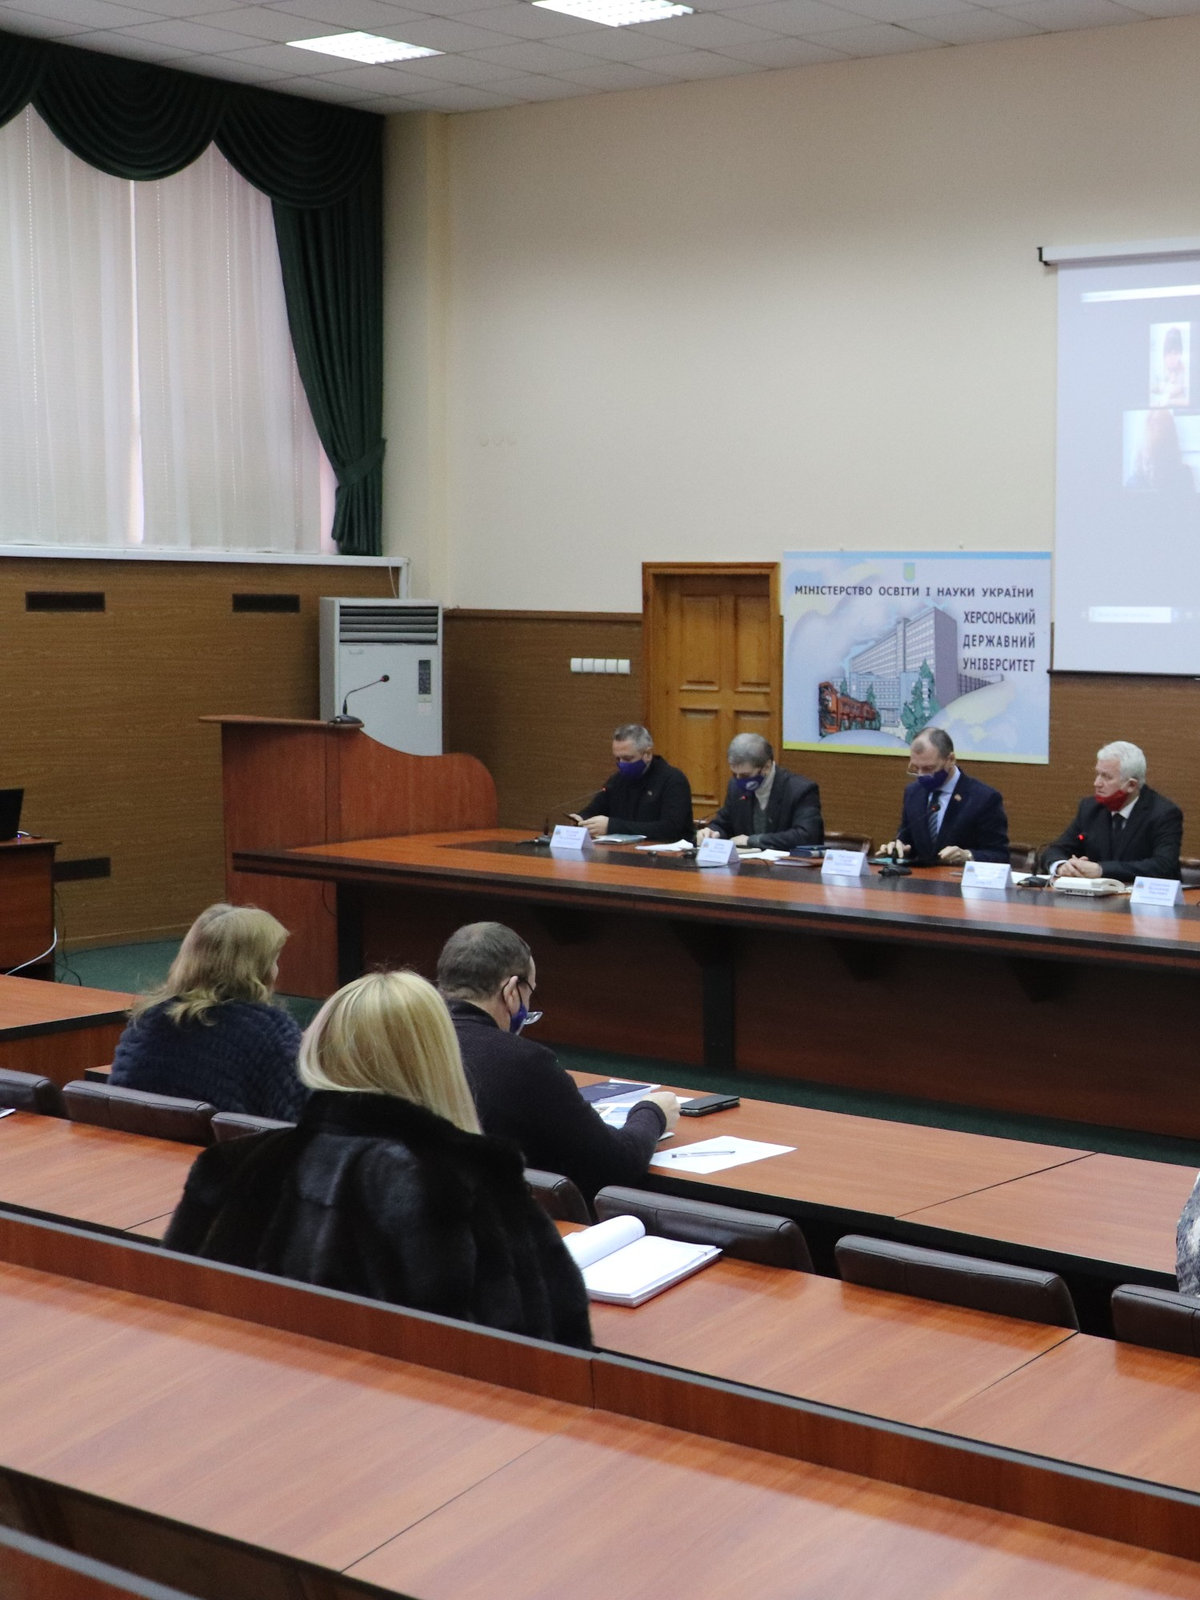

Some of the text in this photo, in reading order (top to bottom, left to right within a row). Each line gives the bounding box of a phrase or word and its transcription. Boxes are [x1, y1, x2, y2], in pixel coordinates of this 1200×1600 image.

[794, 585, 1034, 598] МІНІСТЕРСТВО ОСВІТИ І НАУКИ УКРАЇНИ
[963, 608, 1036, 625] ХЕРСОНСЬКИЙ
[962, 632, 1036, 649] ДЕРЖАВНИЙ
[962, 657, 1035, 672] УНІВЕРСИТЕТ
